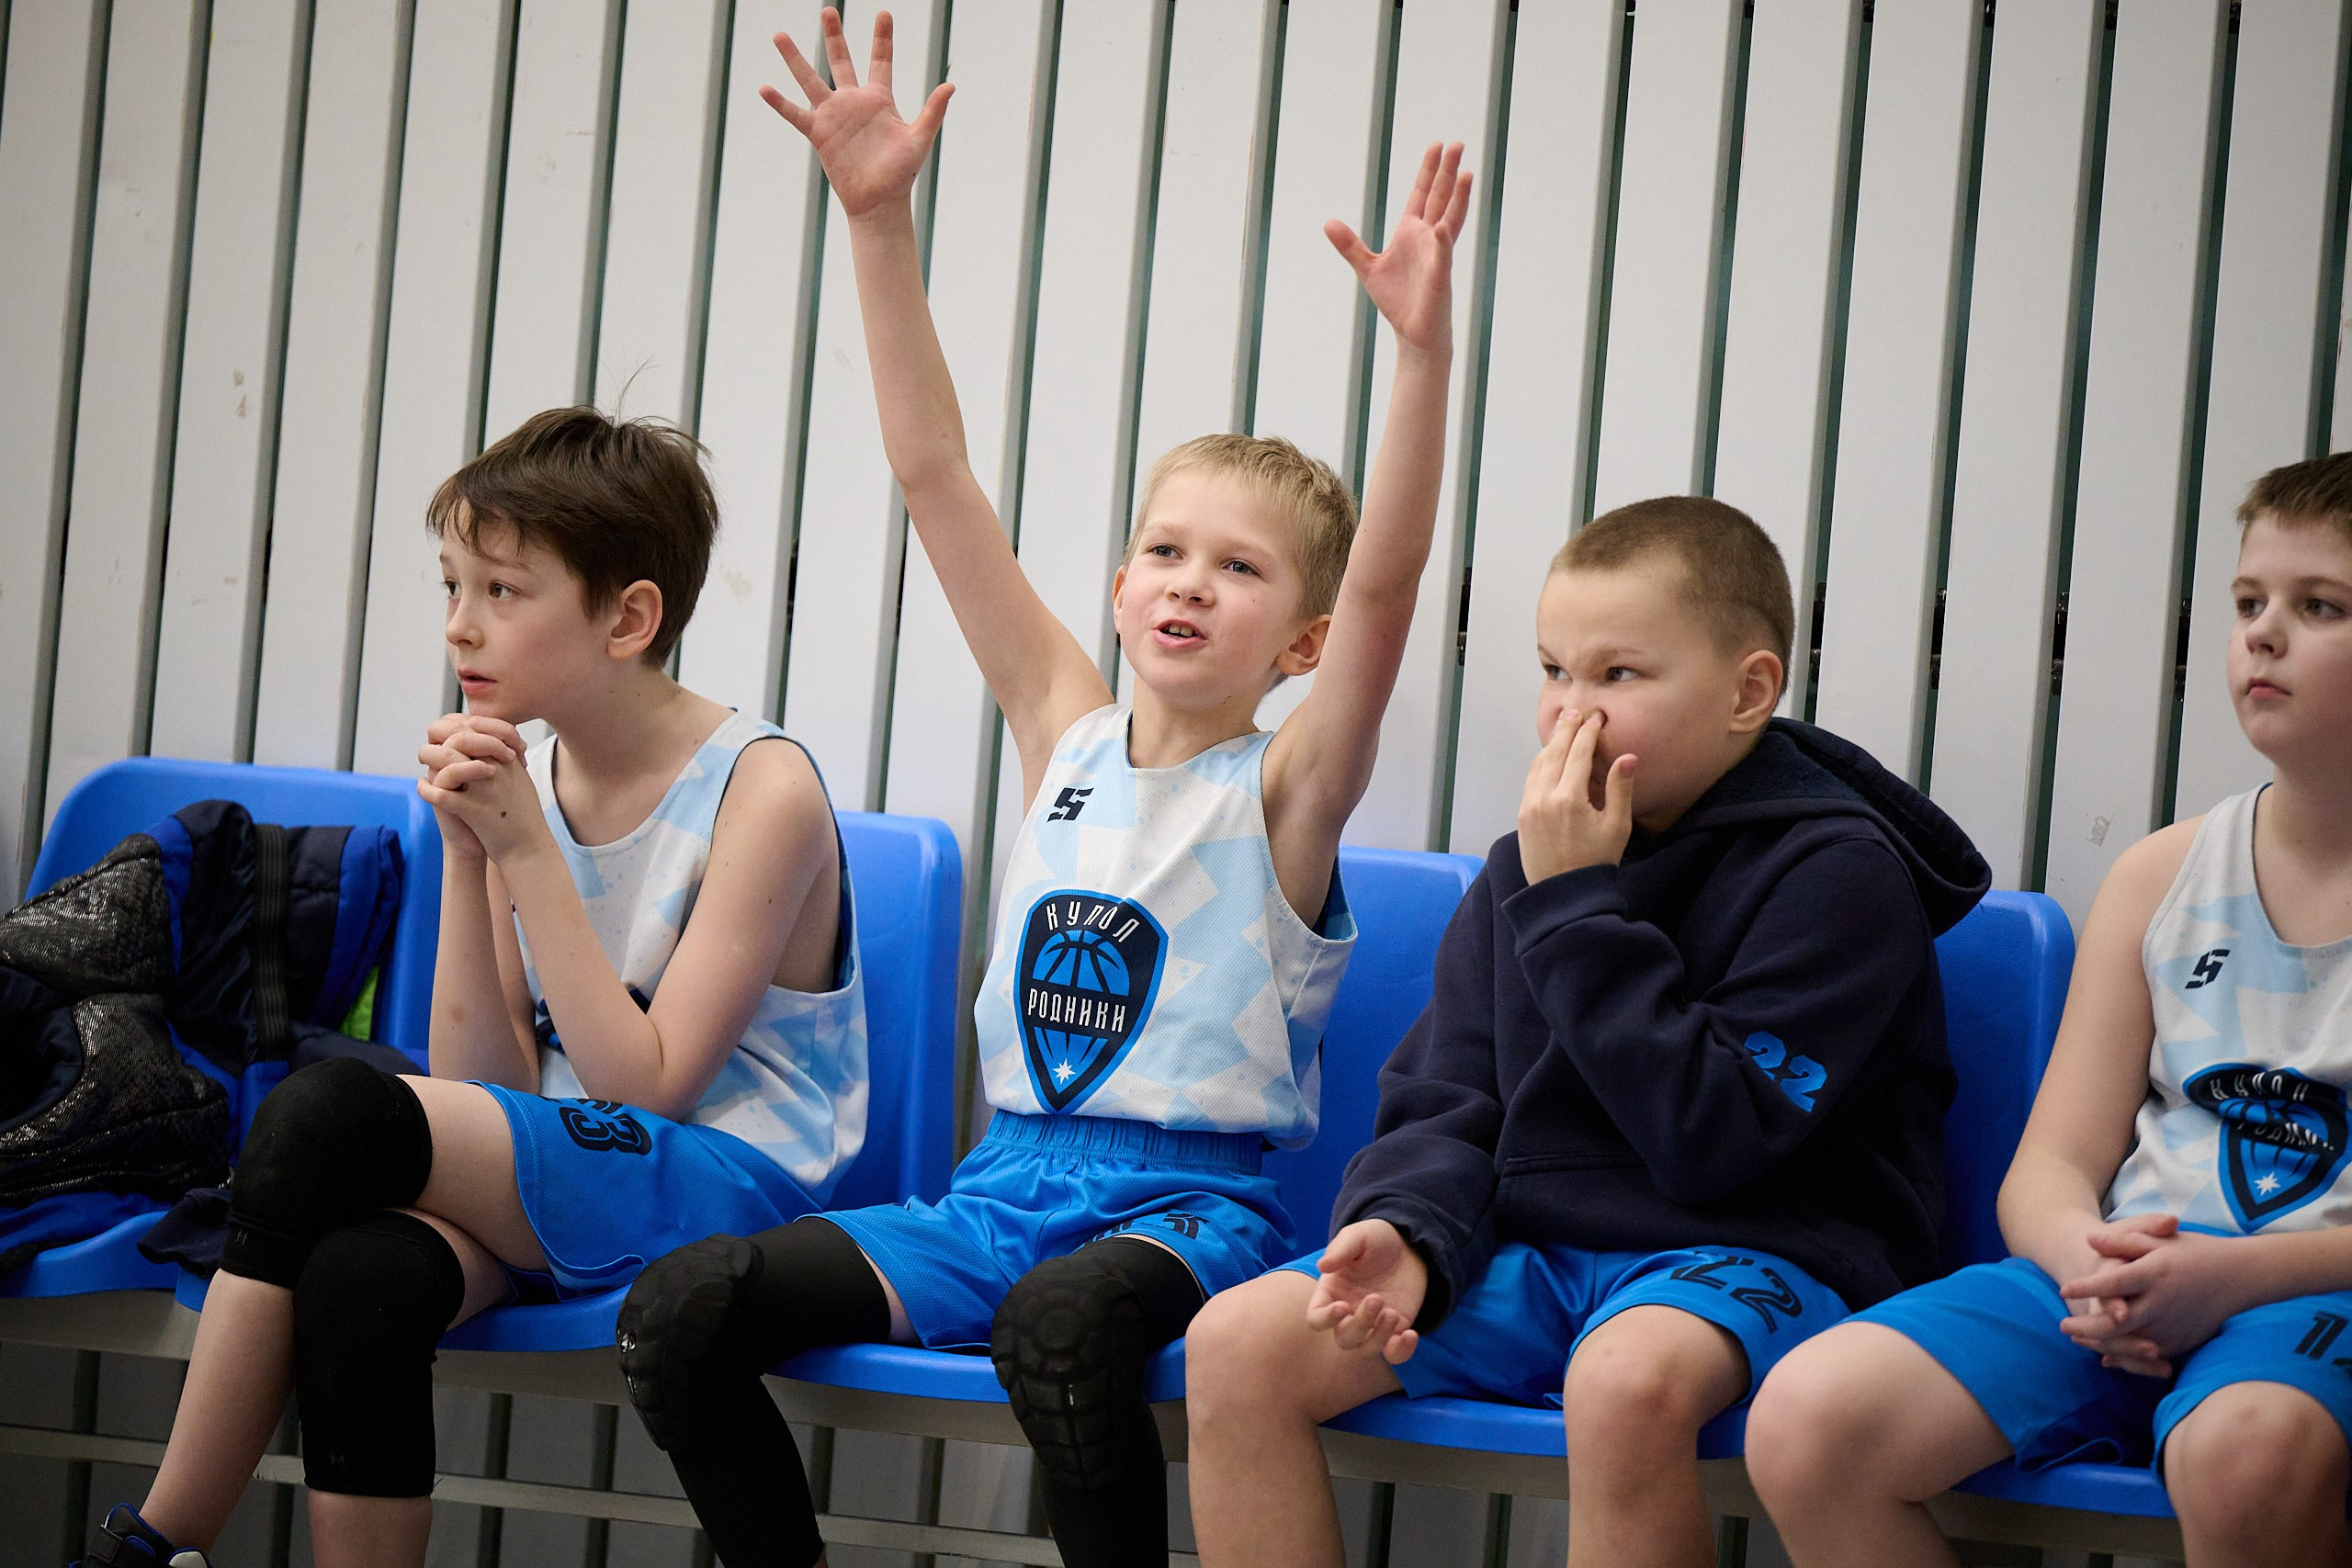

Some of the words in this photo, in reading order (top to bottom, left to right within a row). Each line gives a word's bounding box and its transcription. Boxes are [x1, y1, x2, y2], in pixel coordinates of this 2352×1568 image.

[1046, 901, 1140, 943] КУПОЛ
[1028, 987, 1126, 1032] РОДНИКИ
[1744, 1030, 1828, 1113] 22
